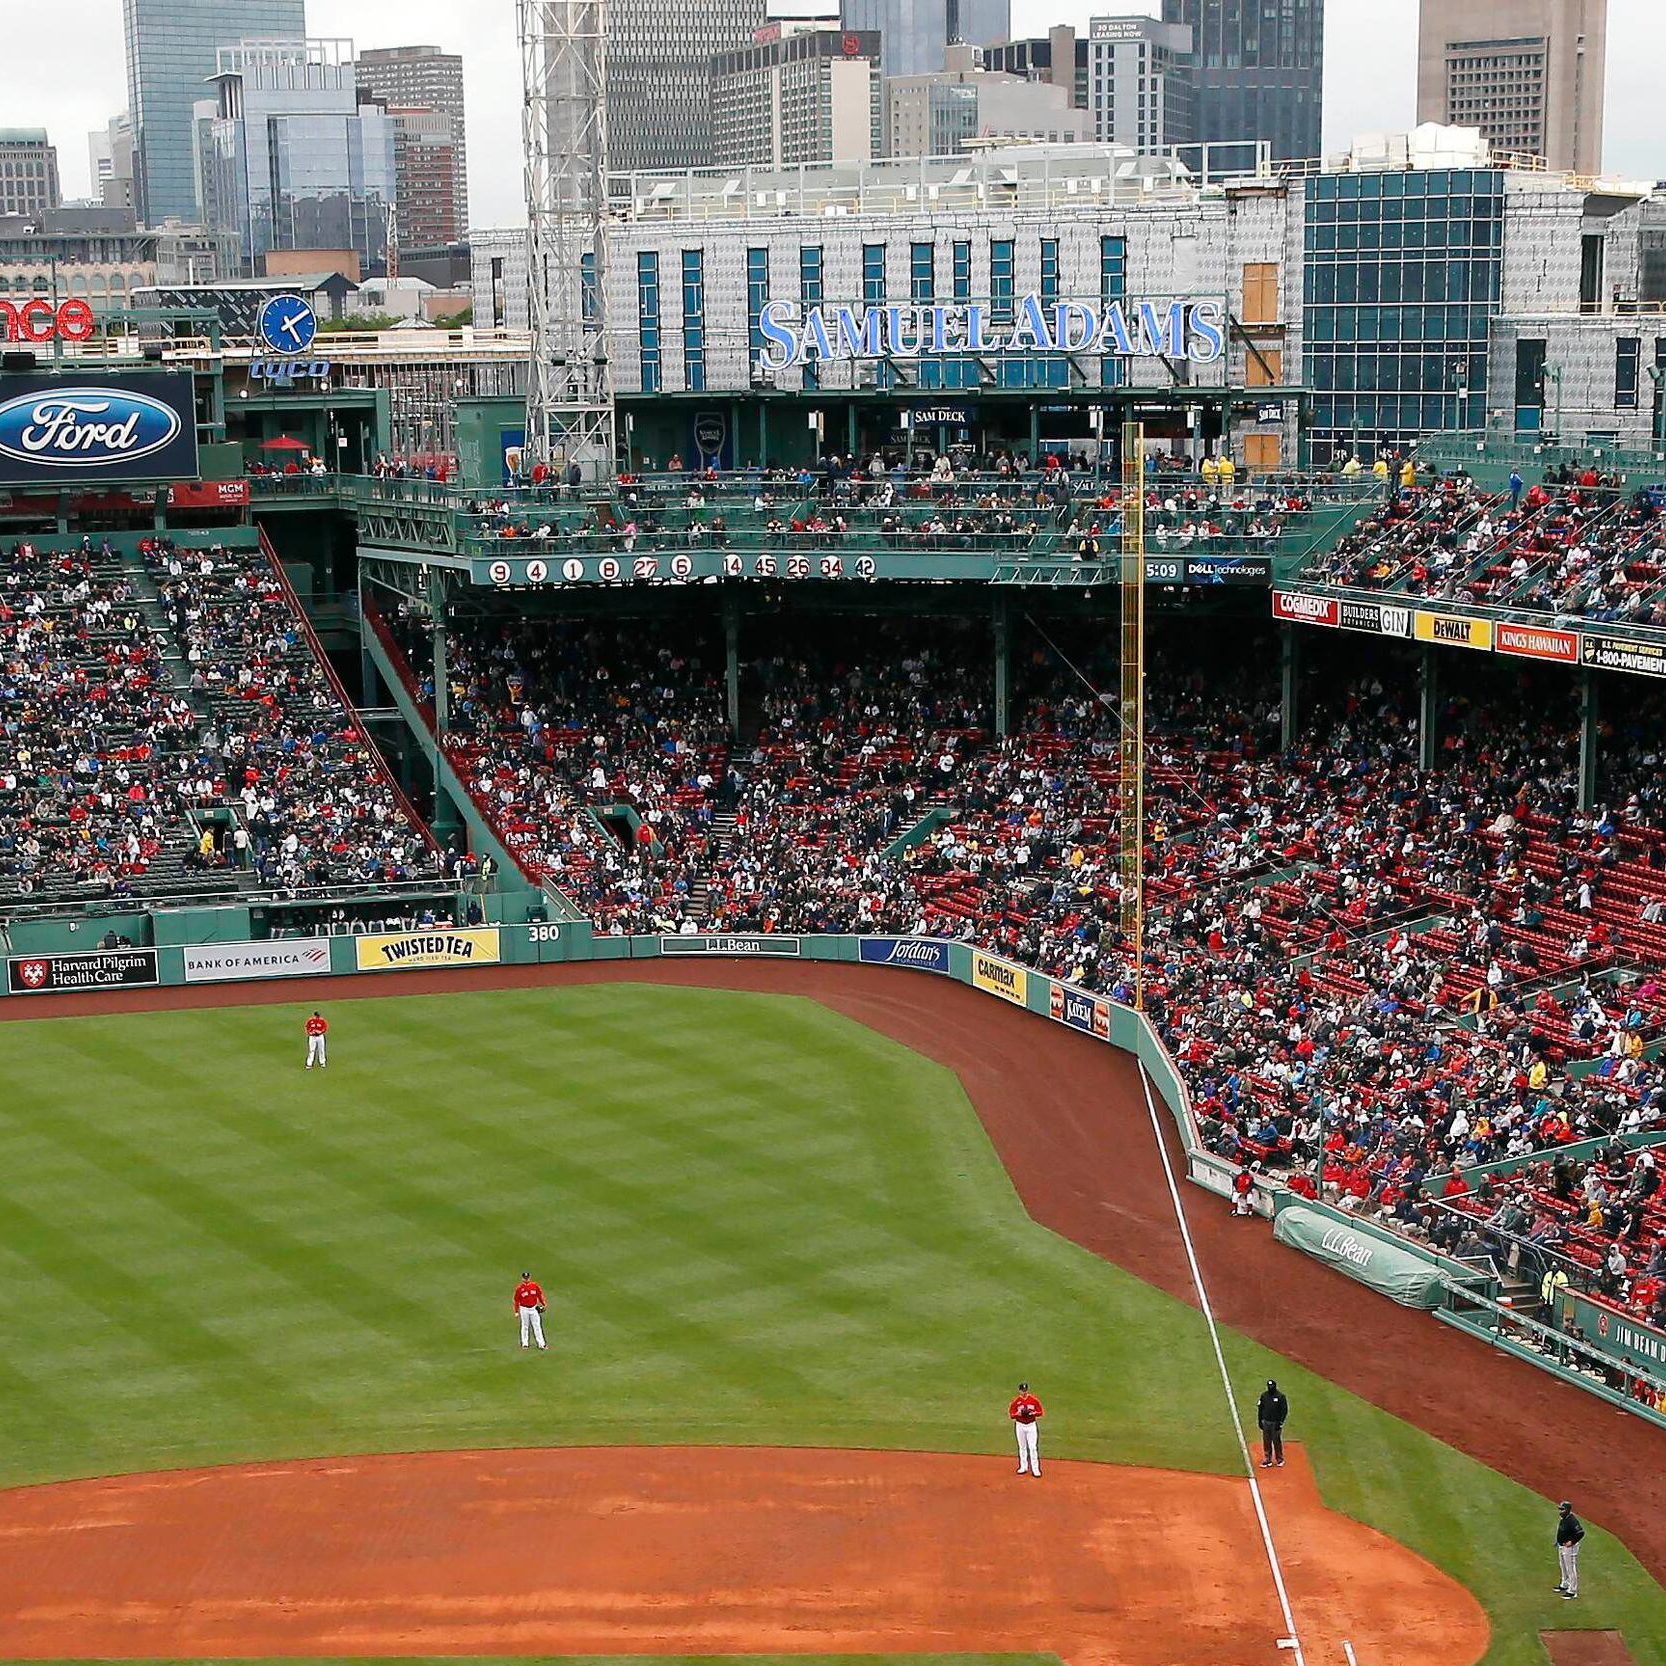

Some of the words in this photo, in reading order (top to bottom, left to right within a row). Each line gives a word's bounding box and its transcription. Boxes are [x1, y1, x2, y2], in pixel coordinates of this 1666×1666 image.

[759, 300, 1002, 371] SAMUEL
[1005, 292, 1227, 363] ADAMS
[22, 400, 139, 451] Ford
[914, 411, 937, 424] SAM
[937, 410, 966, 424] DECK
[218, 483, 244, 495] MGM
[1146, 563, 1177, 578] 5:09
[1280, 594, 1330, 618] COGMEDIX
[1342, 605, 1379, 621] BUILDERS
[1382, 608, 1405, 633] GIN
[1528, 635, 1572, 655] HAWAIIAN
[528, 926, 561, 942] 380
[382, 936, 445, 963] TWISTED
[445, 935, 473, 958] TEA
[705, 938, 760, 952] L.L.Bean
[885, 939, 941, 962] Jordan's
[51, 958, 101, 972] Harvard
[101, 956, 146, 971] Pilgrim
[188, 958, 223, 971] BANK
[225, 957, 242, 968] OF
[243, 954, 300, 967] AMERICA
[1321, 1228, 1373, 1267] L.L.Bean
[1615, 1325, 1632, 1347] JIM
[1634, 1333, 1659, 1359] BEAM
